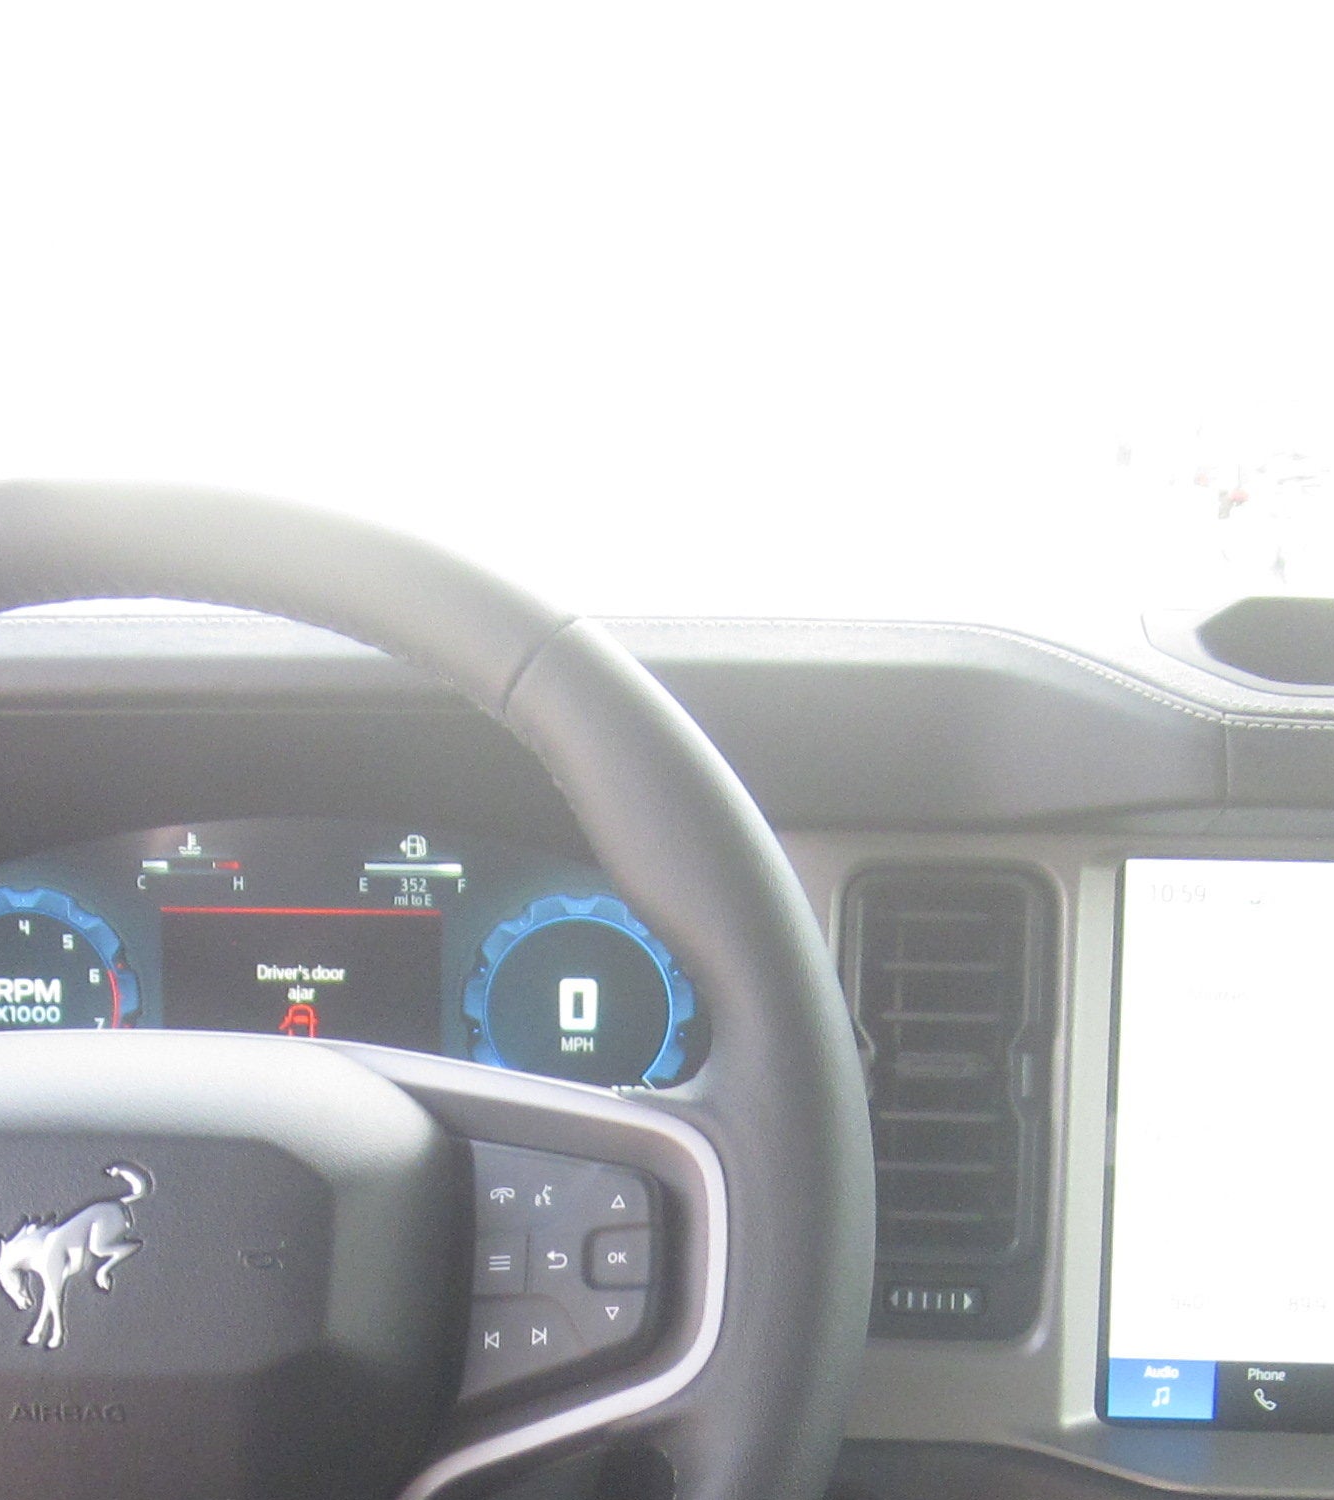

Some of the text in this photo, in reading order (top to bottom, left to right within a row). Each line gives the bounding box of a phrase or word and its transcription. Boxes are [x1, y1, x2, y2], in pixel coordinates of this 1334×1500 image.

[136, 875, 146, 890] C
[233, 876, 244, 891] H
[358, 876, 369, 892] E
[400, 877, 427, 893] 352
[457, 878, 467, 894] F
[411, 895, 423, 906] to
[18, 919, 31, 935] 4
[62, 934, 74, 950] 5
[88, 968, 101, 983] 6
[256, 963, 346, 981] Driver's door
[287, 984, 316, 1003] ajar
[559, 978, 598, 1031] 0
[560, 1037, 595, 1053] MPH
[607, 1251, 628, 1264] OK
[1143, 1365, 1180, 1380] Audio
[1247, 1367, 1286, 1382] Phone
